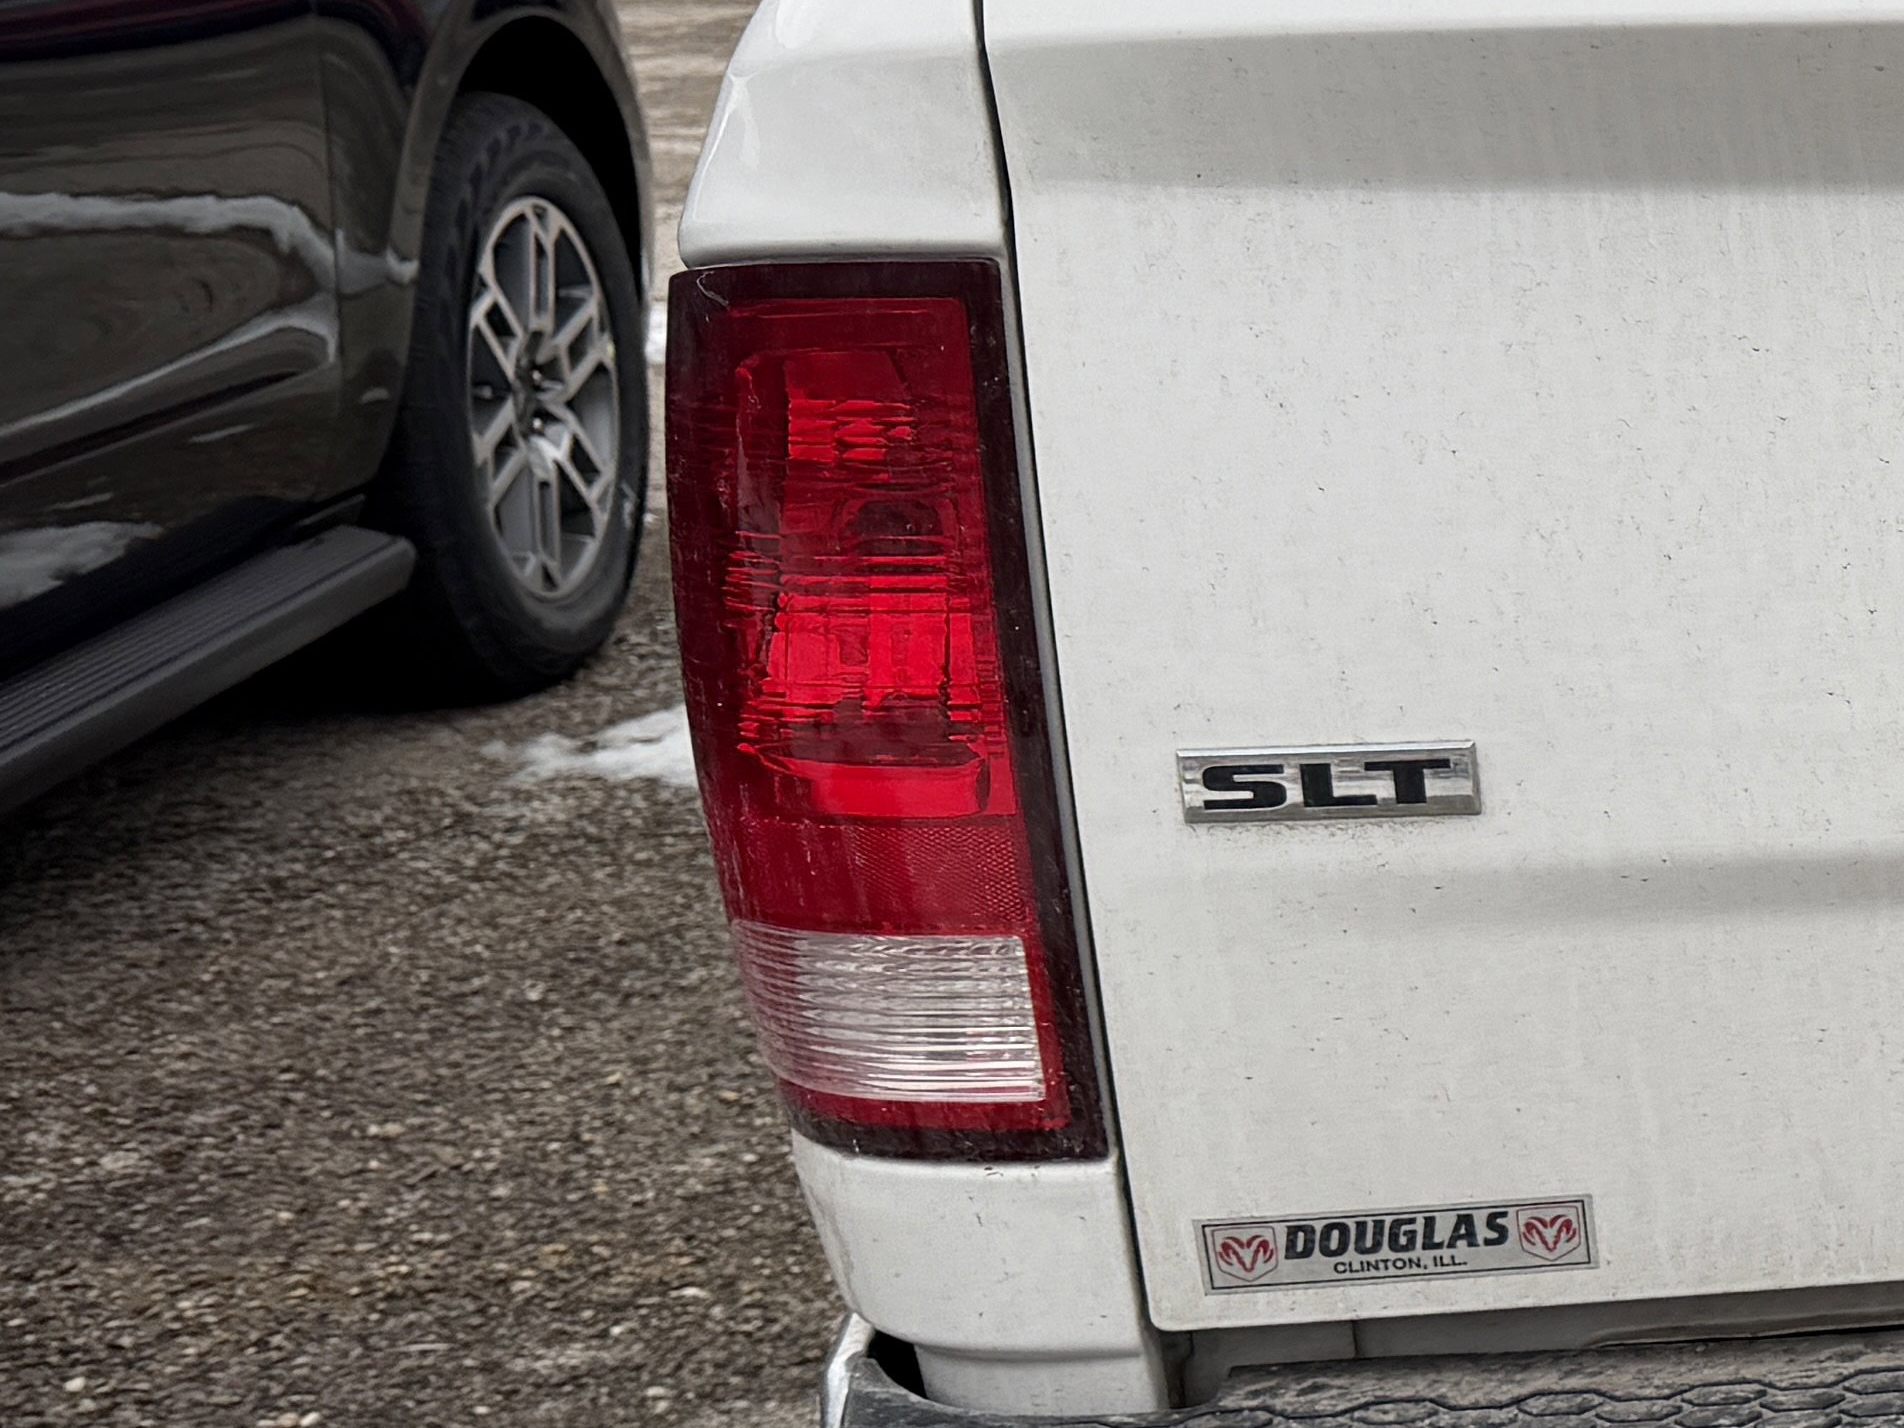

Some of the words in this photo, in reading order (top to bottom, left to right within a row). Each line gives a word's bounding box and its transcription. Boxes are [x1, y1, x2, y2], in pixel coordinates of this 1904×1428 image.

[1202, 758, 1451, 811] SLT
[1283, 1209, 1510, 1260] DOUGLAS
[1333, 1257, 1428, 1275] CLINTON,
[1432, 1255, 1468, 1268] ILL.
